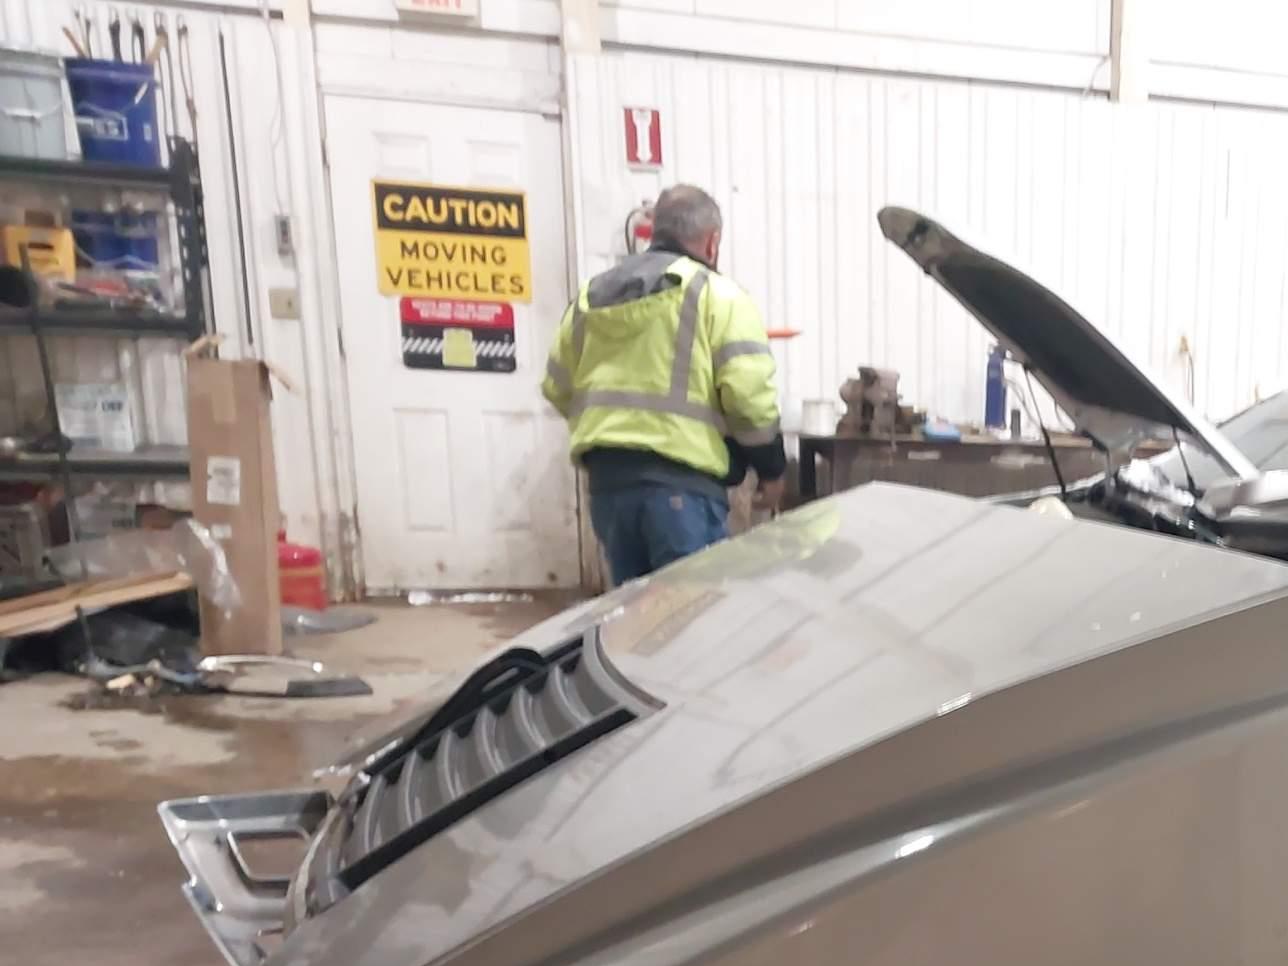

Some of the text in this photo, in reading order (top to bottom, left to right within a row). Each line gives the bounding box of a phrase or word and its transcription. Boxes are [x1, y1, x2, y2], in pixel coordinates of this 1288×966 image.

[383, 194, 519, 229] CAUTION
[400, 239, 507, 265] MOVING
[386, 266, 525, 295] VEHICLES
